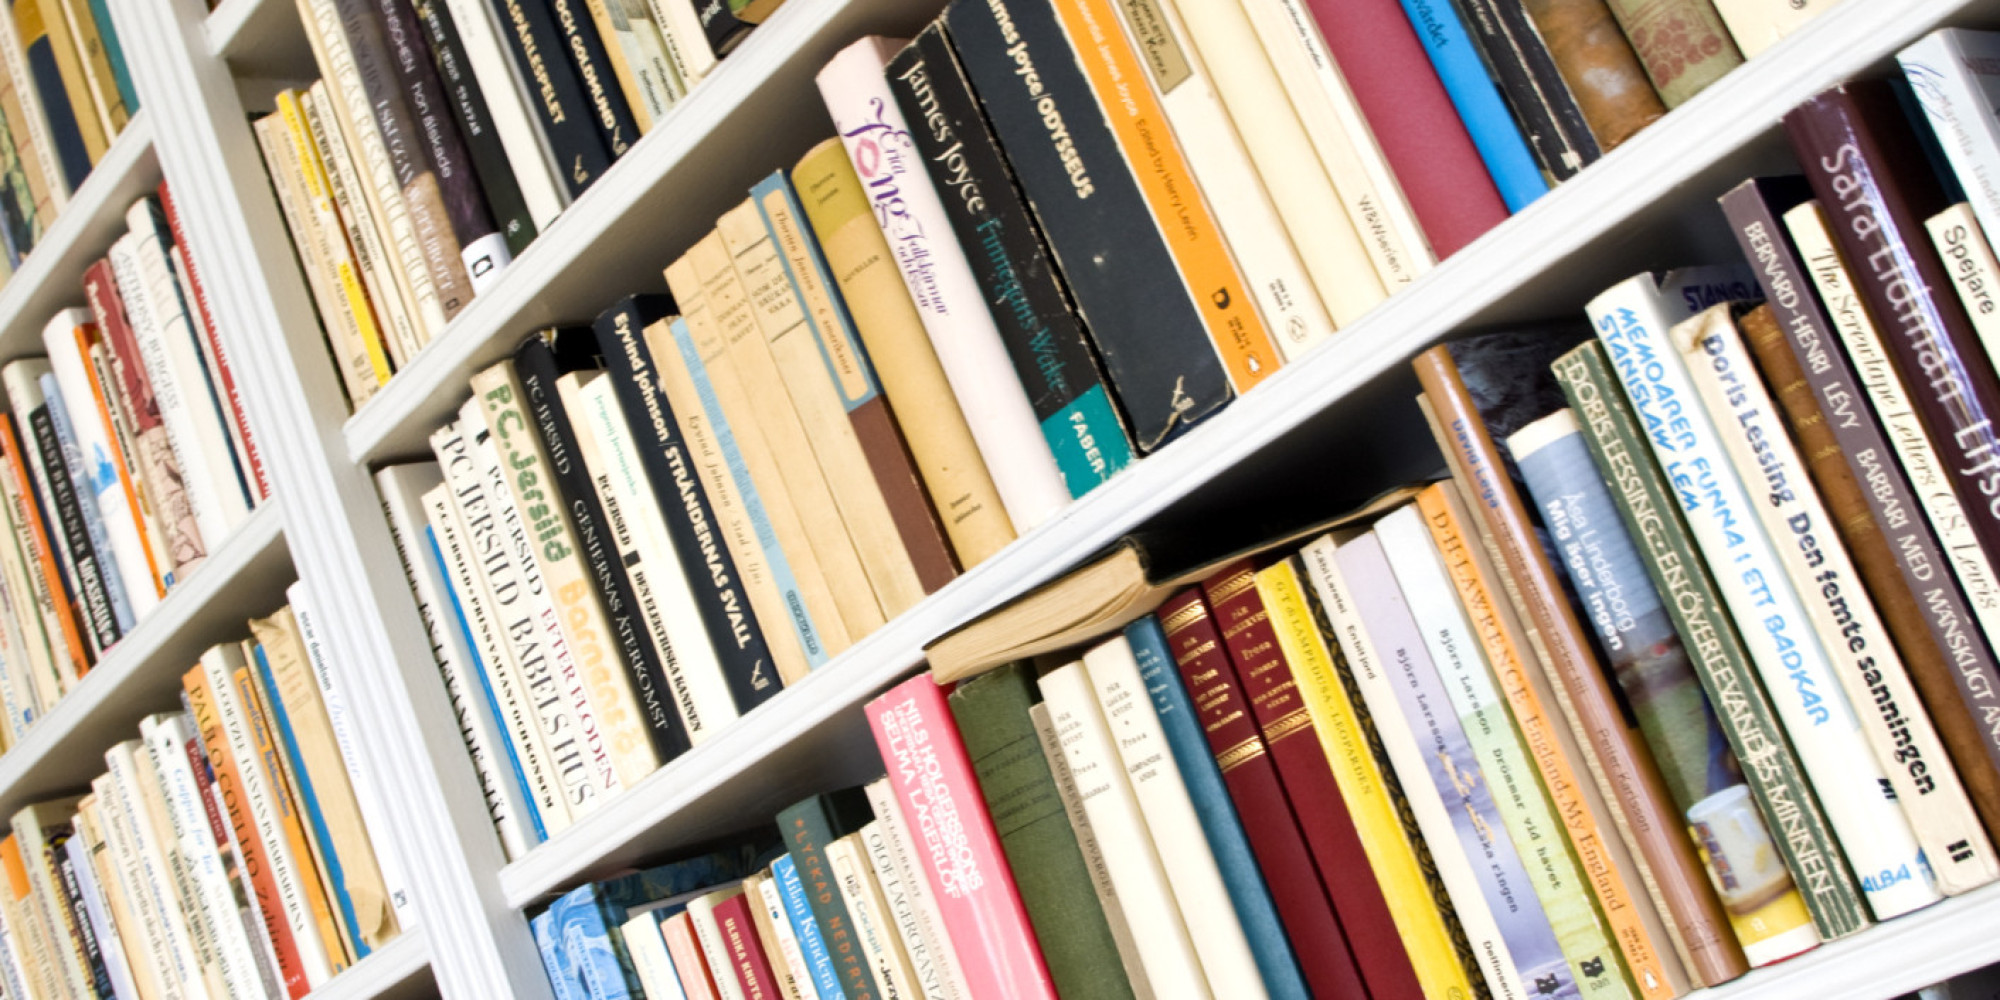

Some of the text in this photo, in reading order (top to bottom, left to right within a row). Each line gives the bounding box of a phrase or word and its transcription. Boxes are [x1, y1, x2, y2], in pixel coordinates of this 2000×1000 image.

[568, 34, 618, 130] GOLDMUND
[986, 0, 1022, 45] ames
[1097, 43, 1123, 82] James
[1411, 0, 1450, 49] värdet
[409, 80, 457, 179] hon älskade
[894, 58, 990, 220] James Joyce
[968, 216, 1044, 334] Finnegans
[1817, 141, 1975, 405] Sara Lidman
[1939, 222, 2000, 316] Spejare
[1025, 325, 1074, 395] Wake
[1596, 312, 1701, 511] STANISLAW LEM
[1807, 245, 1848, 292] The
[1829, 290, 1905, 408] Screwtape
[1886, 407, 1943, 488] Letters
[1950, 538, 2000, 612] Lewis
[33, 416, 87, 555] ERNST BRUNNER
[610, 312, 646, 372] Eyvind
[718, 588, 755, 649] SVALL
[1067, 410, 1107, 475] FABER
[1450, 417, 1502, 510] David Lega
[1615, 302, 1699, 451] MEMOARER
[1687, 455, 1746, 548] FUNNA
[1740, 566, 1775, 611] ETT
[1762, 613, 1831, 727] BADKAR
[1743, 220, 1994, 705] BERNARD-HENRI LÉVY BARBARI MED MÄNSKLIGT
[438, 435, 597, 806] PC JERSILD BABELS HUS
[484, 465, 618, 789] PC JERSILD EFTER FLODEN
[523, 374, 544, 401] PC
[534, 403, 572, 476] JERSILD
[571, 498, 625, 612] GENIERNAS
[614, 613, 670, 732] ÅTERKOMST
[1544, 498, 1624, 652] Mig äger ingen
[1560, 489, 1639, 633] Åsa Linderborg
[1564, 361, 1835, 896] DORIS LESSING EN ÖVERLEVANDES MINNEN
[1700, 332, 1938, 798] Doris Lessing Den femte sanningen
[469, 596, 555, 809] PRINS VALIANT OCH KONSUM
[554, 576, 637, 728] Barnens
[633, 570, 651, 597] DEN
[643, 596, 681, 675] ELEKTRISKA
[673, 675, 703, 732] KANINEN
[188, 686, 225, 768] PAULO
[215, 770, 260, 879] COELHO
[877, 709, 964, 901] SELMA LAGERLÖF
[899, 697, 985, 891] NILS HOLGERSSONS
[1394, 646, 1420, 689] Björn
[1488, 862, 1519, 914] ringen
[1438, 627, 1562, 891] Björn Larsson Drömmar vid havet
[1523, 714, 1573, 798] England,
[1561, 798, 1589, 834] My
[1576, 832, 1625, 913] England
[777, 863, 811, 915] Milan
[798, 914, 841, 989] Kundera
[794, 830, 833, 905] LYCKAD
[852, 899, 883, 955] Cockpit
[867, 831, 897, 879] OLOF
[1858, 860, 1912, 898] ALBA
[721, 917, 748, 961] ULRIKA
